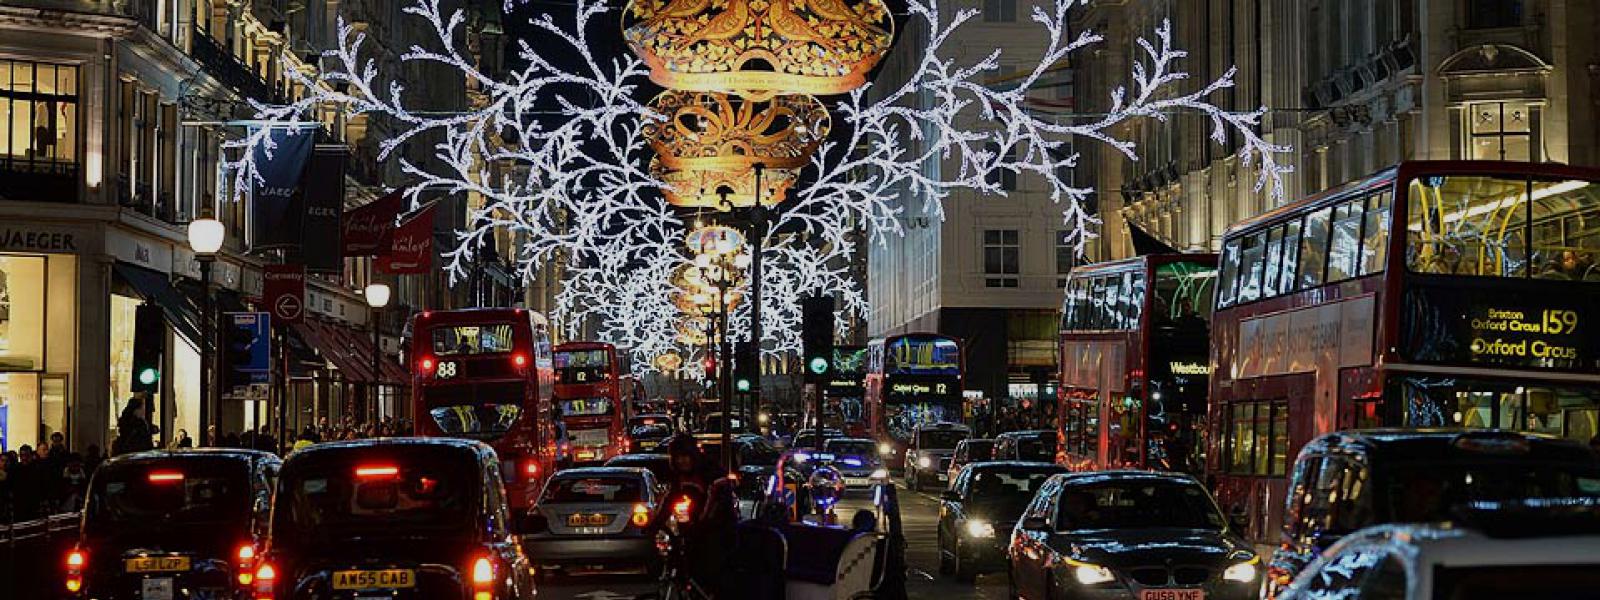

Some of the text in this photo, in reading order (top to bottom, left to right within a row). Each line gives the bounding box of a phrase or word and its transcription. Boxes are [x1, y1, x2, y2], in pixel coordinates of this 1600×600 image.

[0, 229, 76, 251] JAEGER
[1488, 307, 1524, 320] Brixton
[1471, 318, 1541, 333] Oxford Circus
[1542, 308, 1578, 335] 159
[1472, 338, 1577, 360] Oxford Circus
[437, 361, 456, 379] 88
[577, 371, 587, 381] 12
[936, 383, 947, 395] 12
[380, 570, 409, 585] CAB
